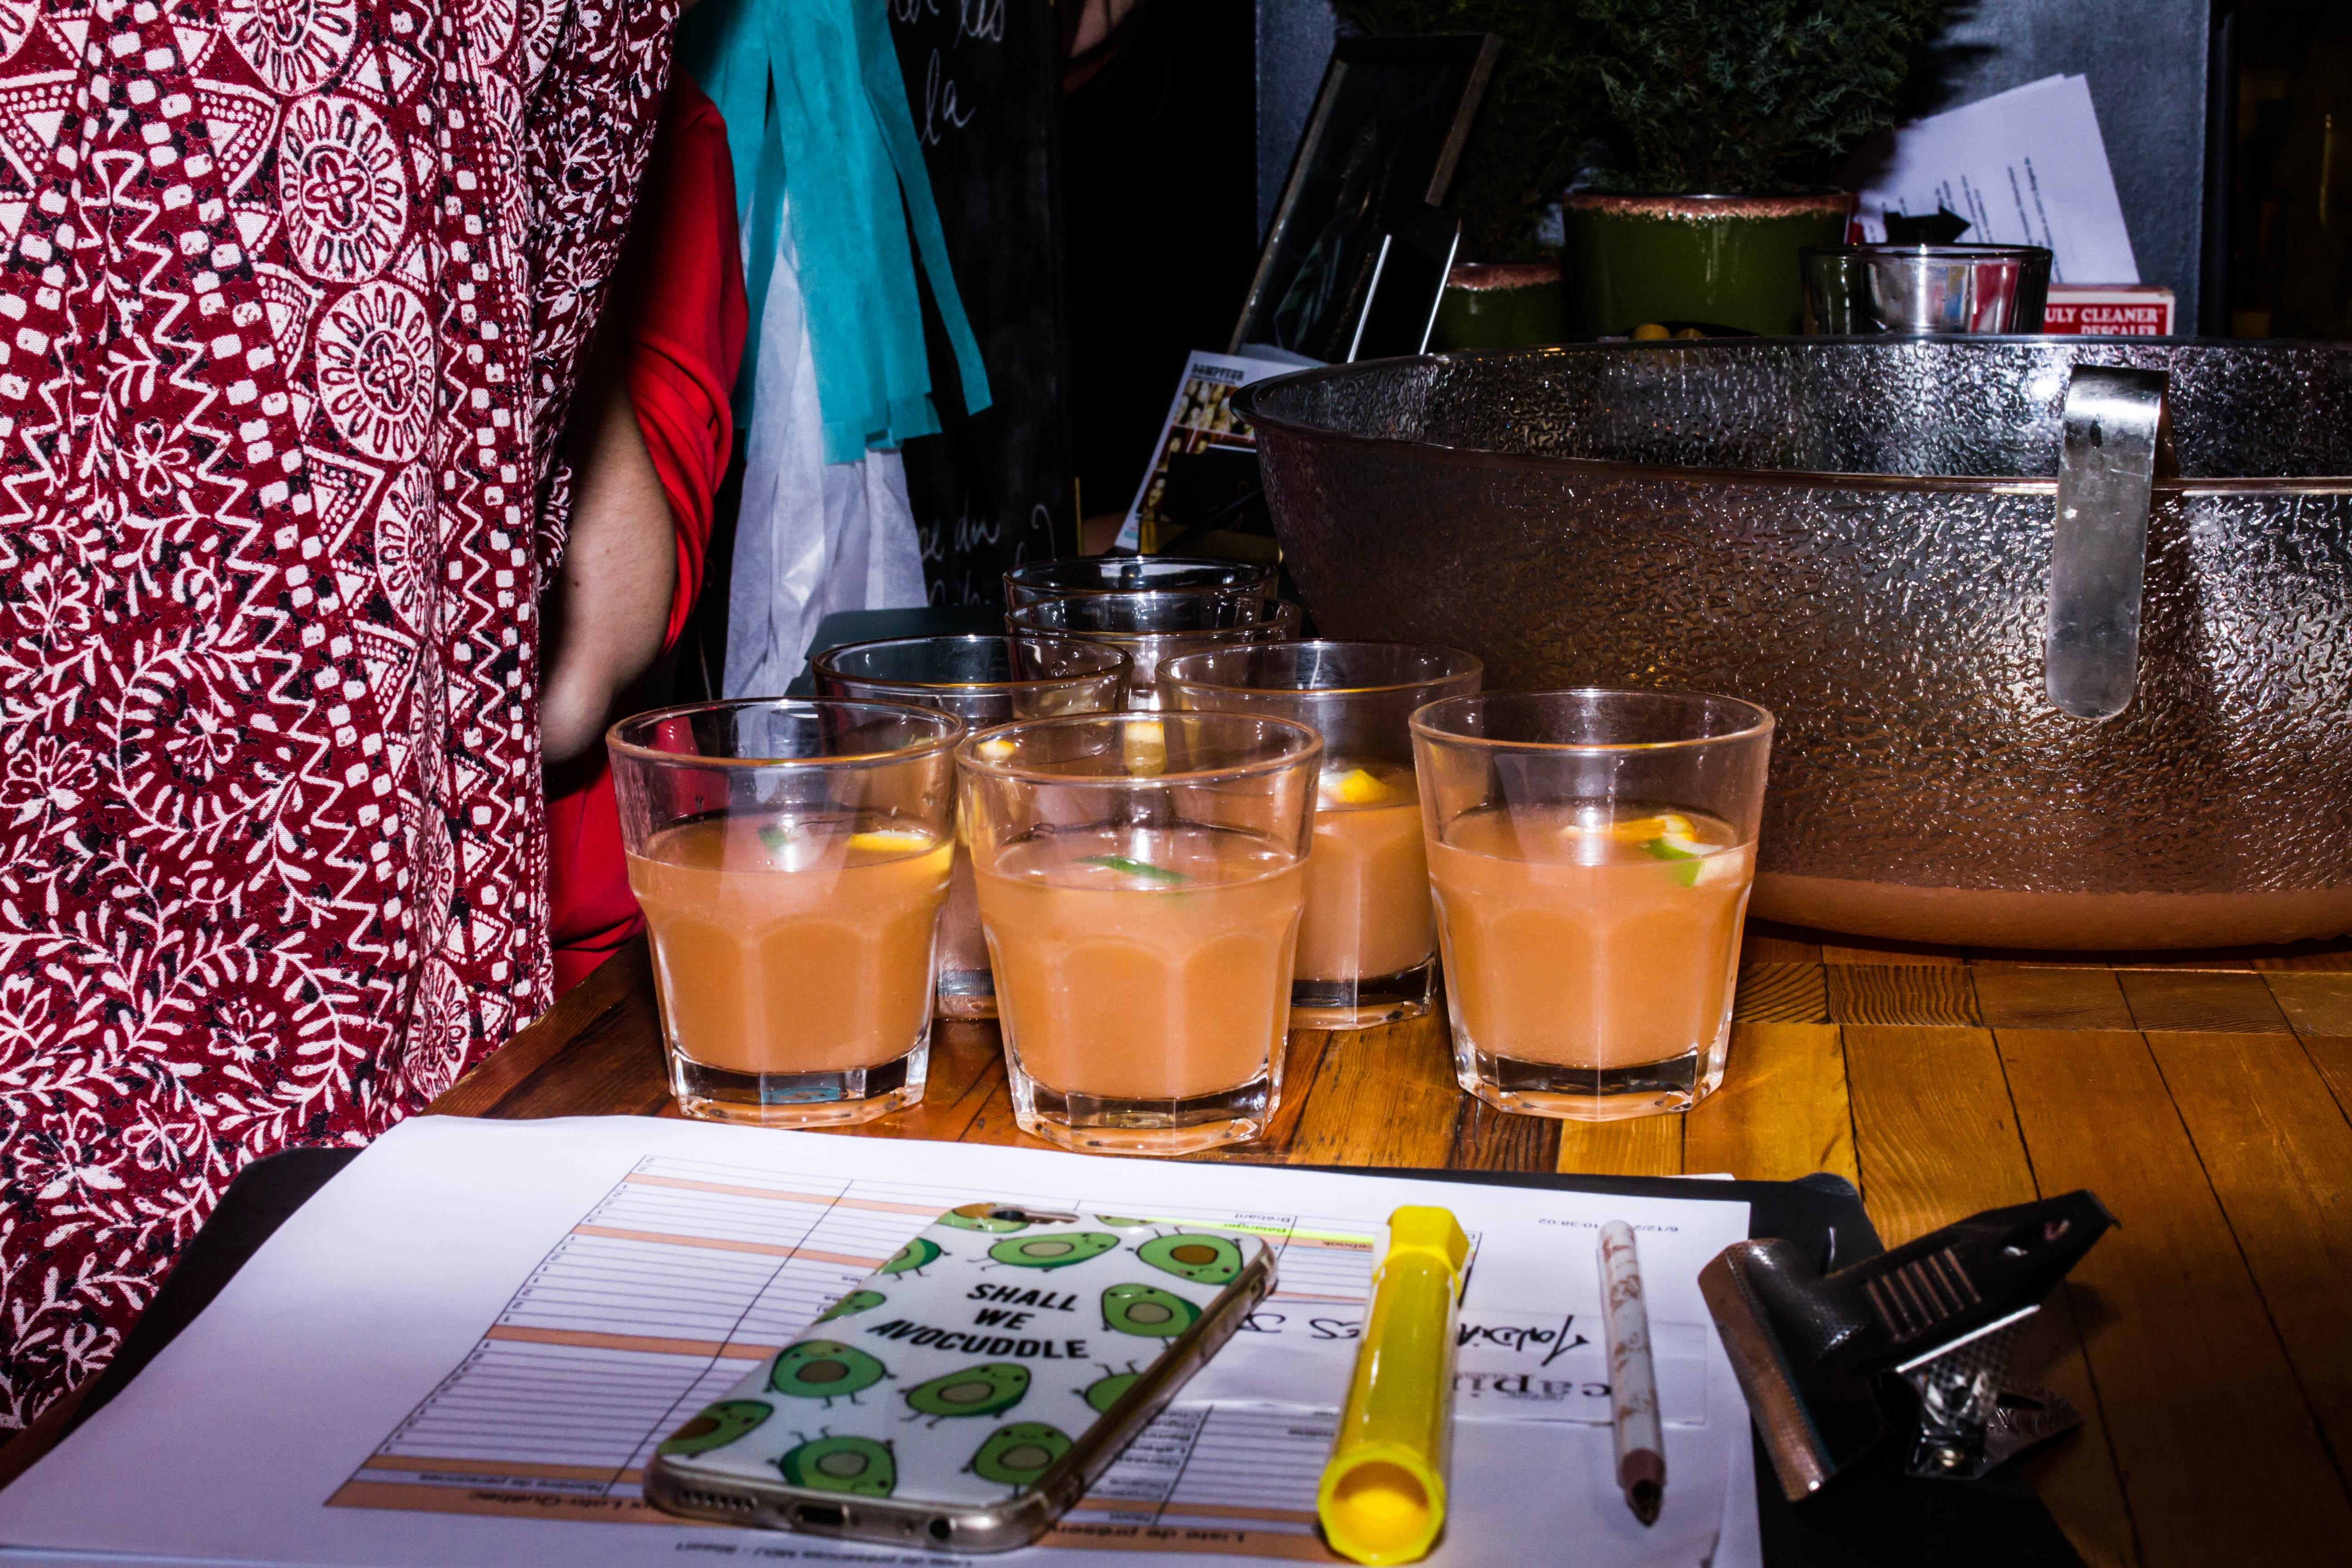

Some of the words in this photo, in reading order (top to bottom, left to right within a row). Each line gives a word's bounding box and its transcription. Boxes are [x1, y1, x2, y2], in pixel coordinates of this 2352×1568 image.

[2045, 308, 2078, 323] ULY
[2081, 307, 2158, 323] CLEANER
[1224, 1224, 1286, 1233] Bélanger
[967, 1284, 1078, 1312] SHALL
[974, 1308, 1035, 1330] WE
[866, 1320, 1089, 1358] AVOCUDDLE
